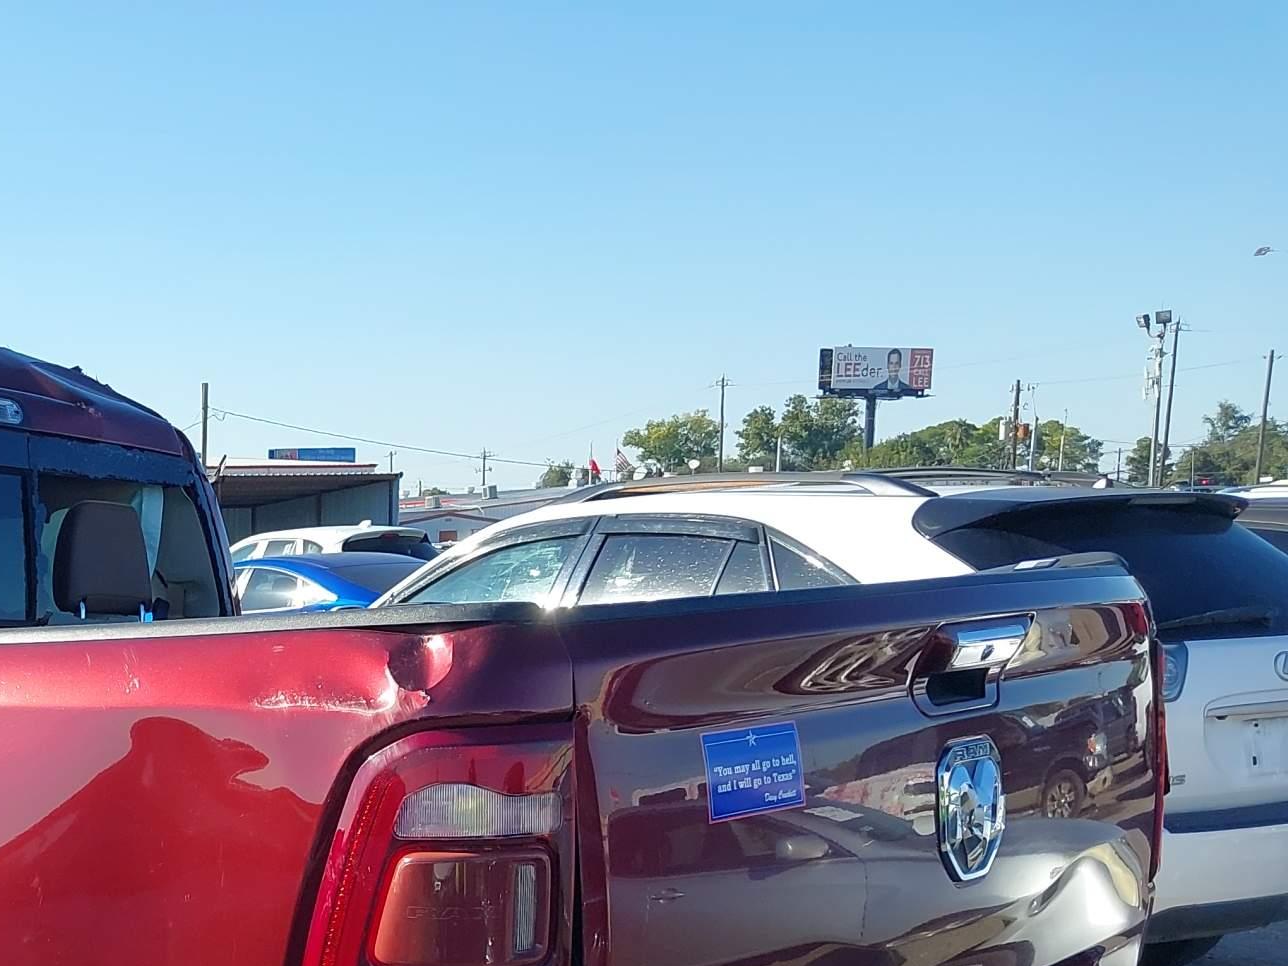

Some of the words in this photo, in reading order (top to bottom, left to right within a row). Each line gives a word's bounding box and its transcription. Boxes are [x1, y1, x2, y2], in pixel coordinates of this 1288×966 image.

[837, 352, 852, 361] Call
[854, 352, 868, 361] the
[913, 355, 930, 368] 713
[836, 362, 883, 378] LEEder.
[913, 377, 929, 387] LEE
[954, 742, 990, 761] RAM
[734, 763, 749, 774] may
[752, 760, 760, 770] all
[762, 761, 770, 772] go
[772, 758, 779, 767] to
[781, 754, 796, 765] hell,
[717, 781, 731, 793] and
[738, 778, 752, 789] will
[753, 779, 762, 789] go
[764, 775, 771, 784] to
